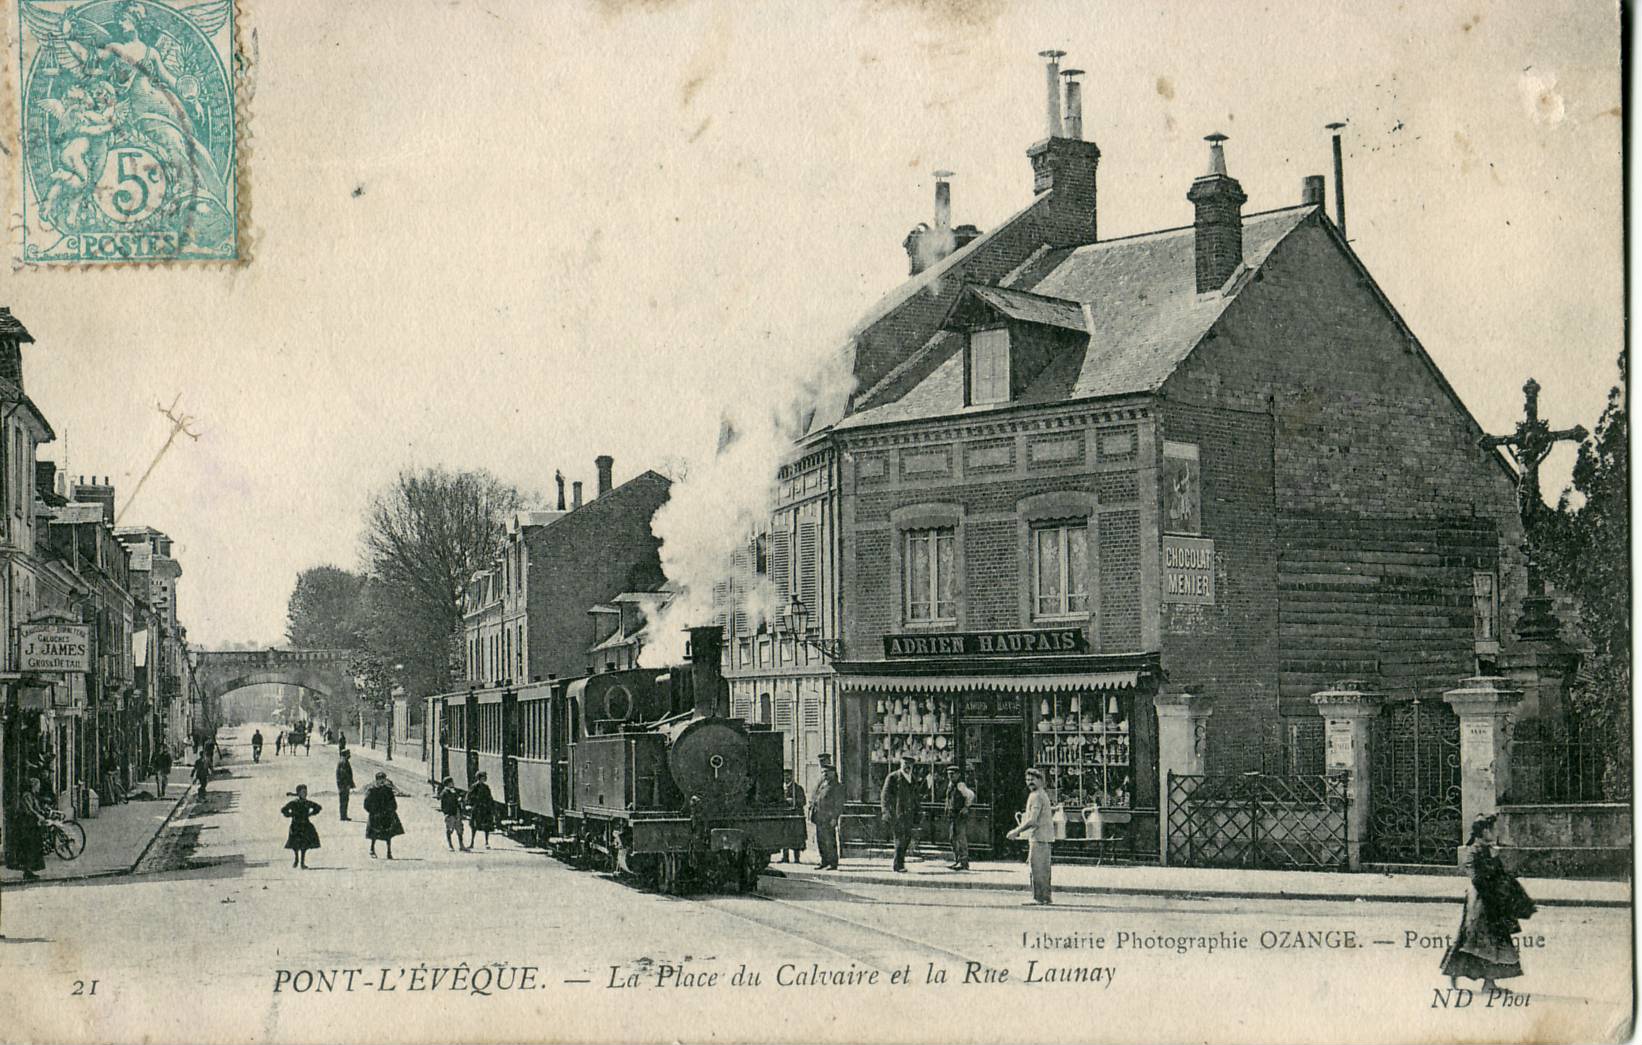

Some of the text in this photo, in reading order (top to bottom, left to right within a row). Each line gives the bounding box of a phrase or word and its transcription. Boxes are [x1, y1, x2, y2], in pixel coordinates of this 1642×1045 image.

[82, 235, 176, 256] POSTES
[1166, 546, 1211, 571] CHOCOLAT
[1168, 573, 1210, 597] MENIER
[41, 643, 86, 656] JAMES
[889, 631, 1076, 655] ADRIEN HAUPAIS
